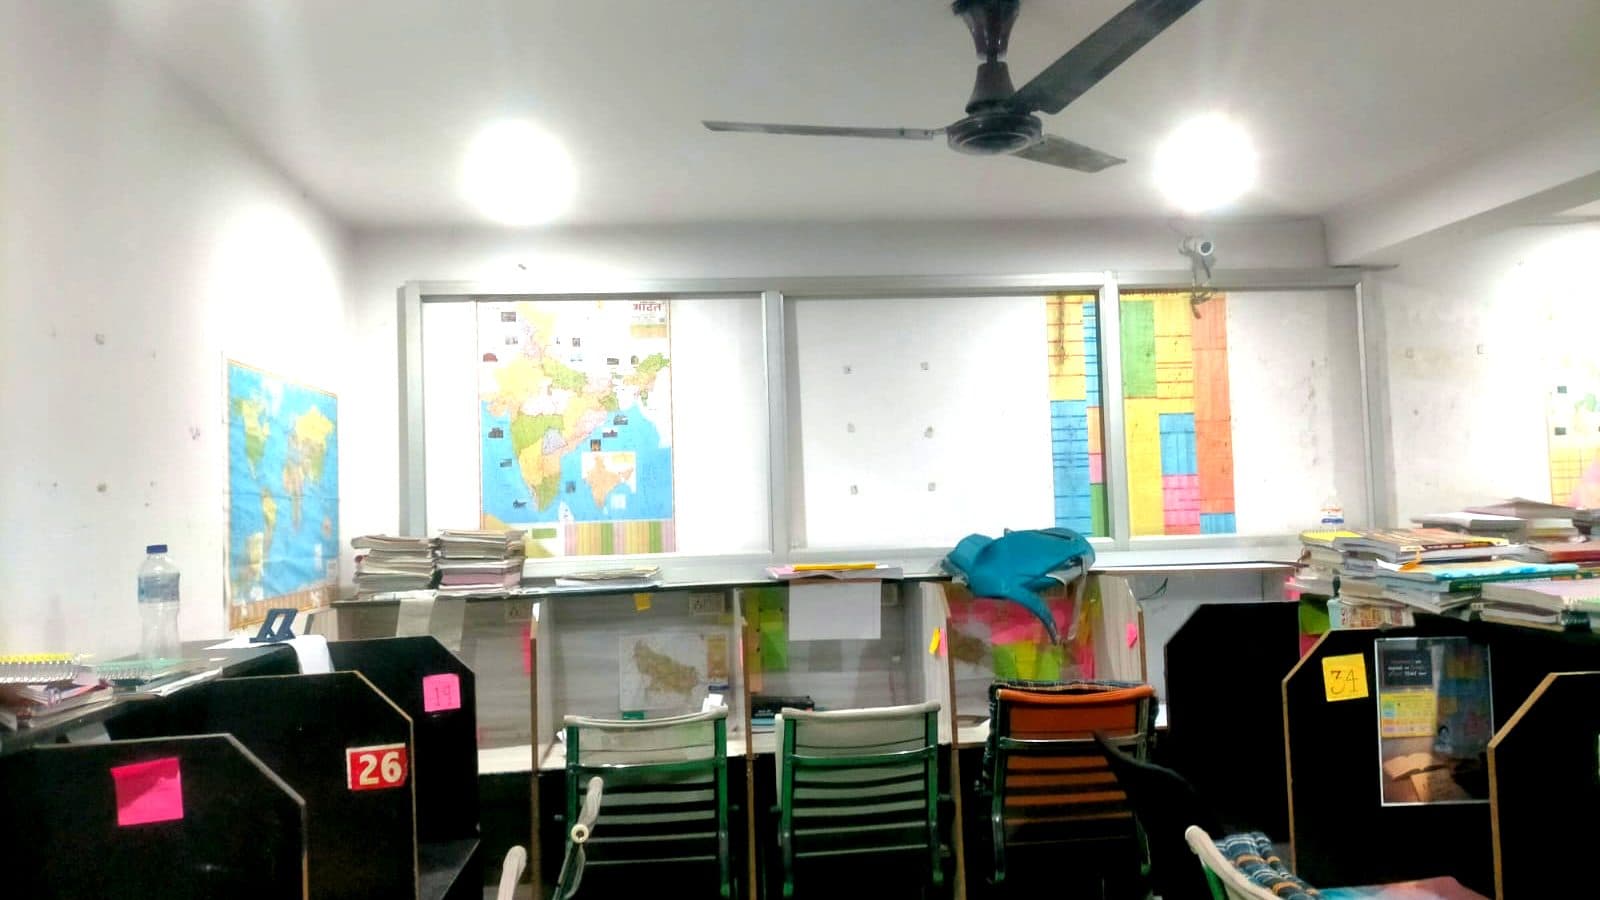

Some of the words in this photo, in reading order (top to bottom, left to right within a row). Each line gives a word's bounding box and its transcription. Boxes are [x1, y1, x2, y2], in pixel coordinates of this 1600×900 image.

[1330, 669, 1360, 695] 34
[433, 684, 453, 707] 19
[360, 751, 402, 786] 26
